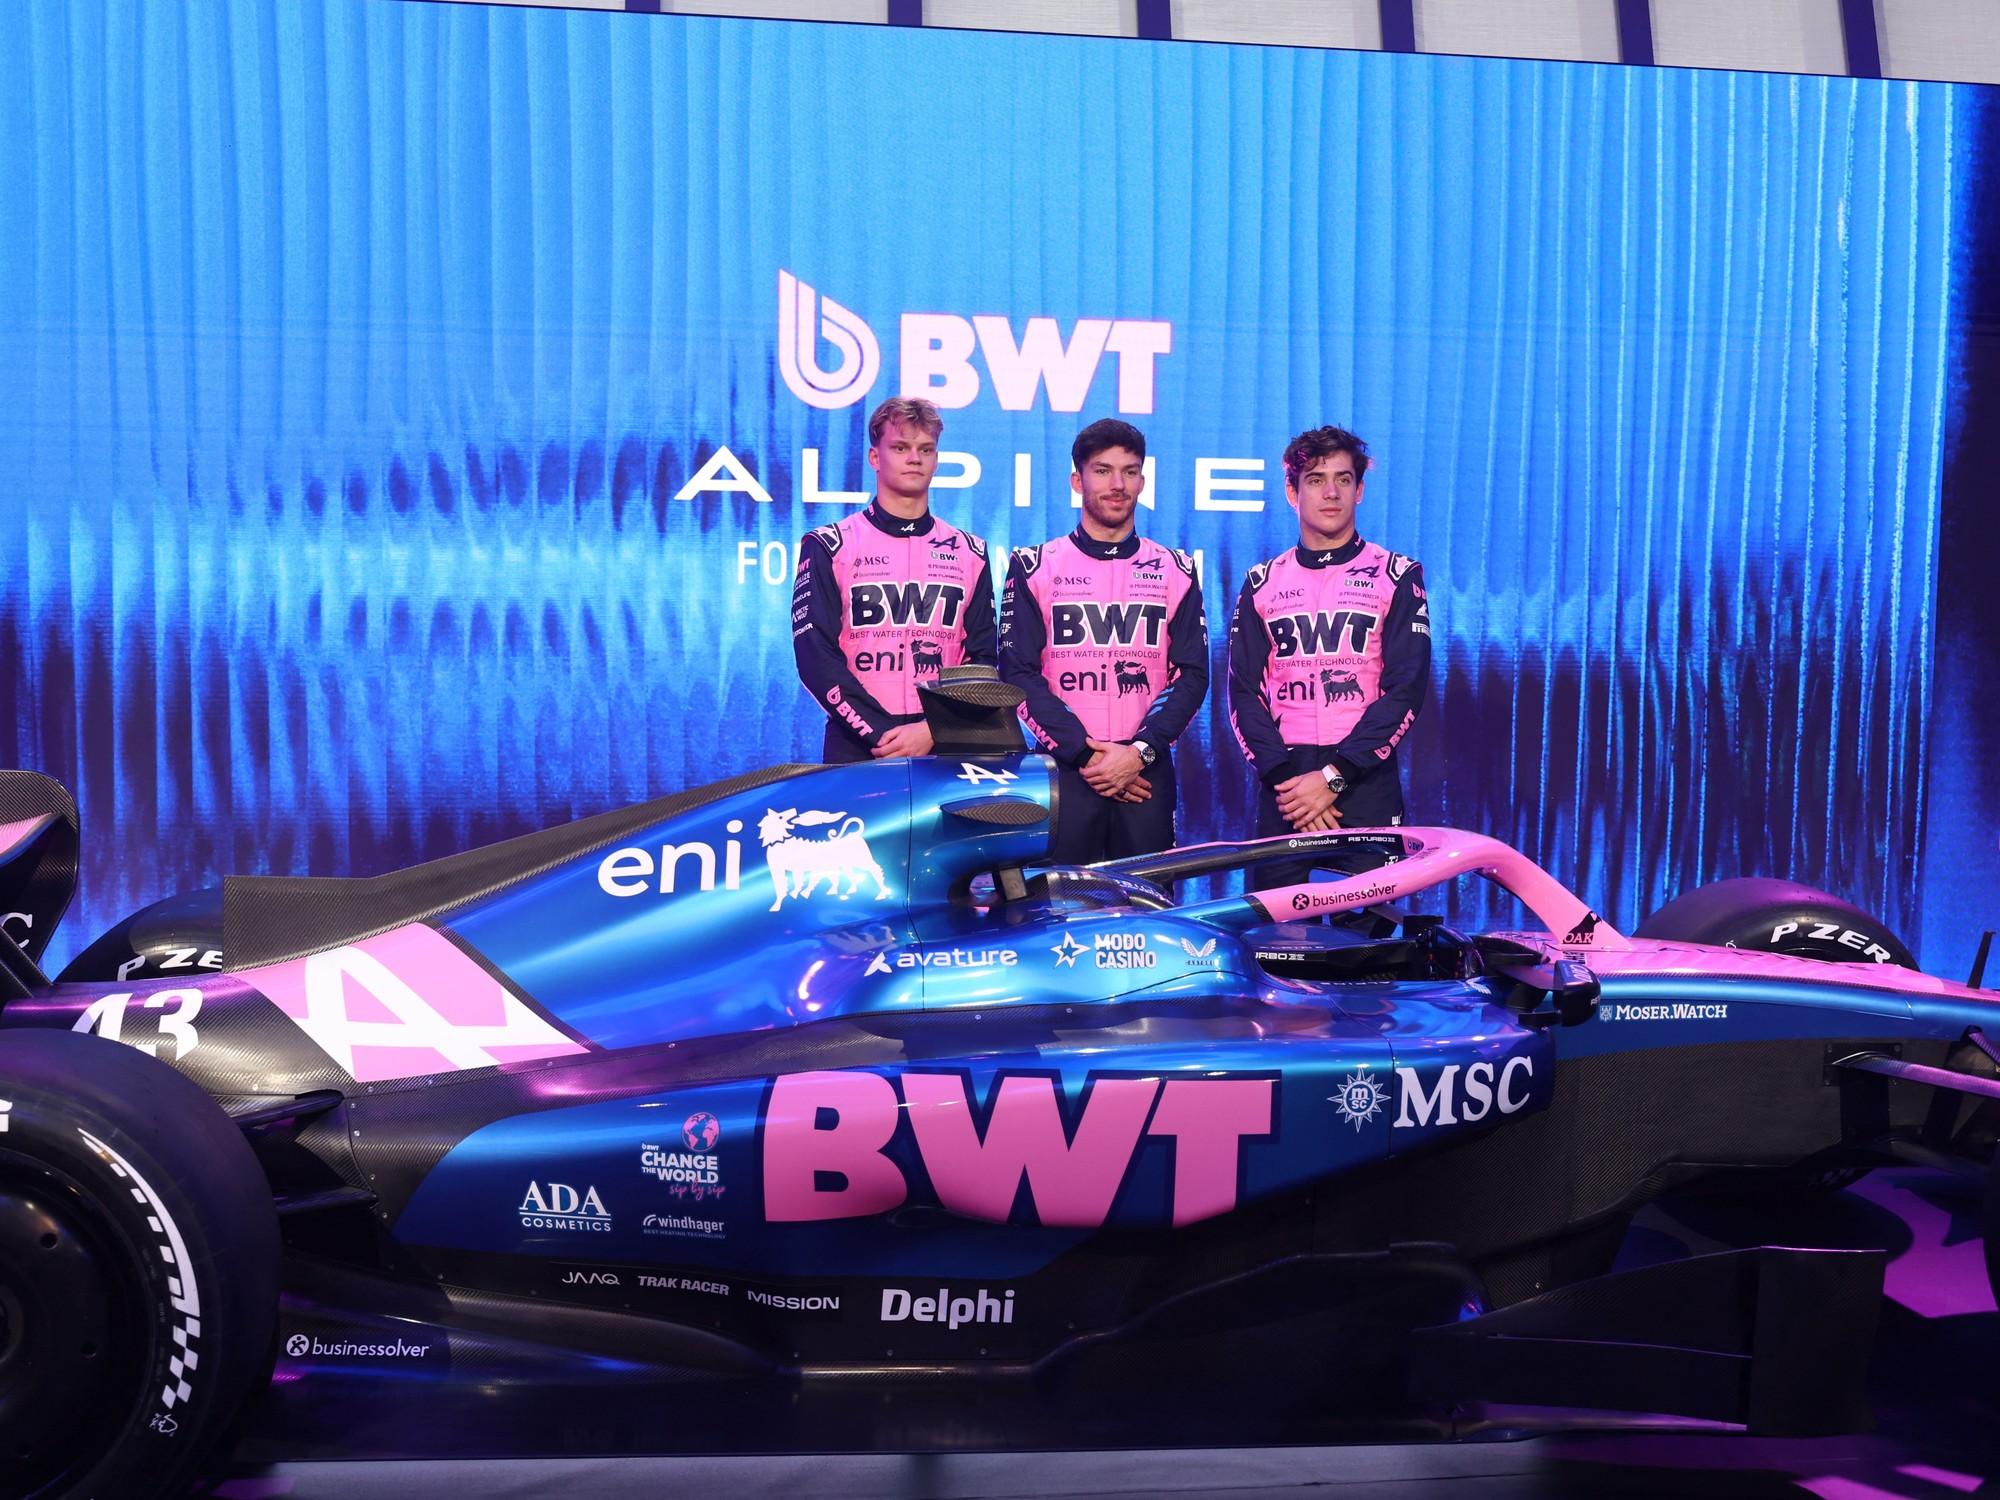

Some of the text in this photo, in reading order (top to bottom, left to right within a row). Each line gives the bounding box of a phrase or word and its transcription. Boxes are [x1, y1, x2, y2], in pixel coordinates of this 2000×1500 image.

[901, 312, 1172, 415] BWT
[674, 444, 1266, 512] ALPIE
[864, 556, 890, 566] MSC
[1064, 576, 1092, 585] MSC
[1142, 573, 1163, 581] BWT
[850, 582, 965, 628] BWT
[1278, 588, 1305, 600] MSC
[850, 630, 870, 640] BEST
[872, 630, 902, 638] WATER
[1051, 602, 1168, 648] BWT
[1267, 610, 1380, 660] BWT
[855, 643, 905, 672] eni
[1051, 651, 1071, 659] BEST
[1059, 664, 1107, 692] eni
[1277, 673, 1315, 701] eni
[838, 704, 873, 737] BWT
[1388, 708, 1416, 748] BWT
[1028, 717, 1059, 751] BWT
[1298, 837, 1339, 847] businessolver
[598, 819, 744, 898] eni
[1312, 883, 1397, 907] businessolver
[1095, 934, 1146, 951] MODO
[1770, 922, 1901, 967] P ZER
[117, 947, 223, 982] P ZE
[897, 948, 1018, 968] avature
[1095, 951, 1157, 969] CASINO
[71, 968, 204, 1062] 43
[1615, 1004, 1728, 1021] MOSER.WATCH
[1393, 1055, 1533, 1128] MSC
[641, 1151, 719, 1170] CHANGE
[763, 1071, 1274, 1229] BWT
[641, 1166, 719, 1184] THE WORLD
[518, 1180, 611, 1217] ADA
[669, 1183, 687, 1199] sip
[707, 1184, 726, 1200] sip
[521, 1216, 612, 1232] COSMETICS
[658, 1215, 725, 1234] windhager
[638, 1275, 730, 1296] TRAK RACER
[747, 1290, 840, 1310] MISSION
[881, 1288, 1016, 1330] Delphi
[312, 1338, 430, 1358] businessolver
